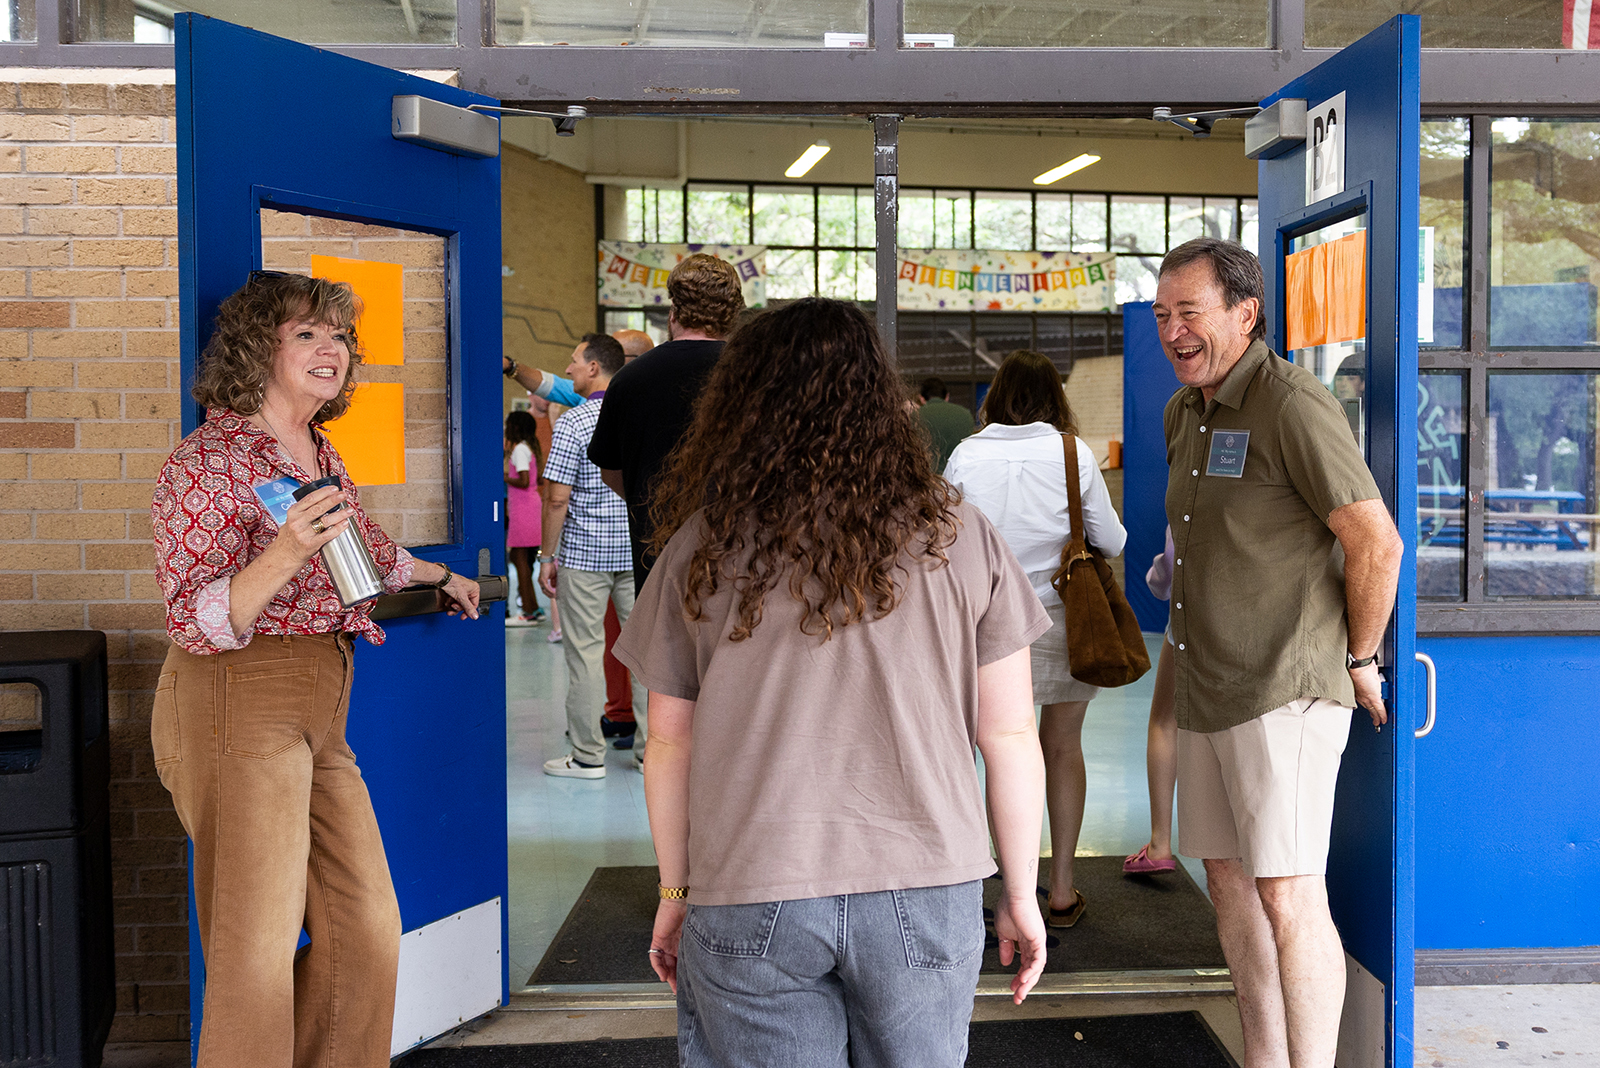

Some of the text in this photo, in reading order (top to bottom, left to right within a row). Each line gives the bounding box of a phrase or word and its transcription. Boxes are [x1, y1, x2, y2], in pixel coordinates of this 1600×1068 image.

[1313, 107, 1337, 191] B2
[610, 257, 756, 287] WELE
[901, 264, 1102, 290] BIENVENIDOS
